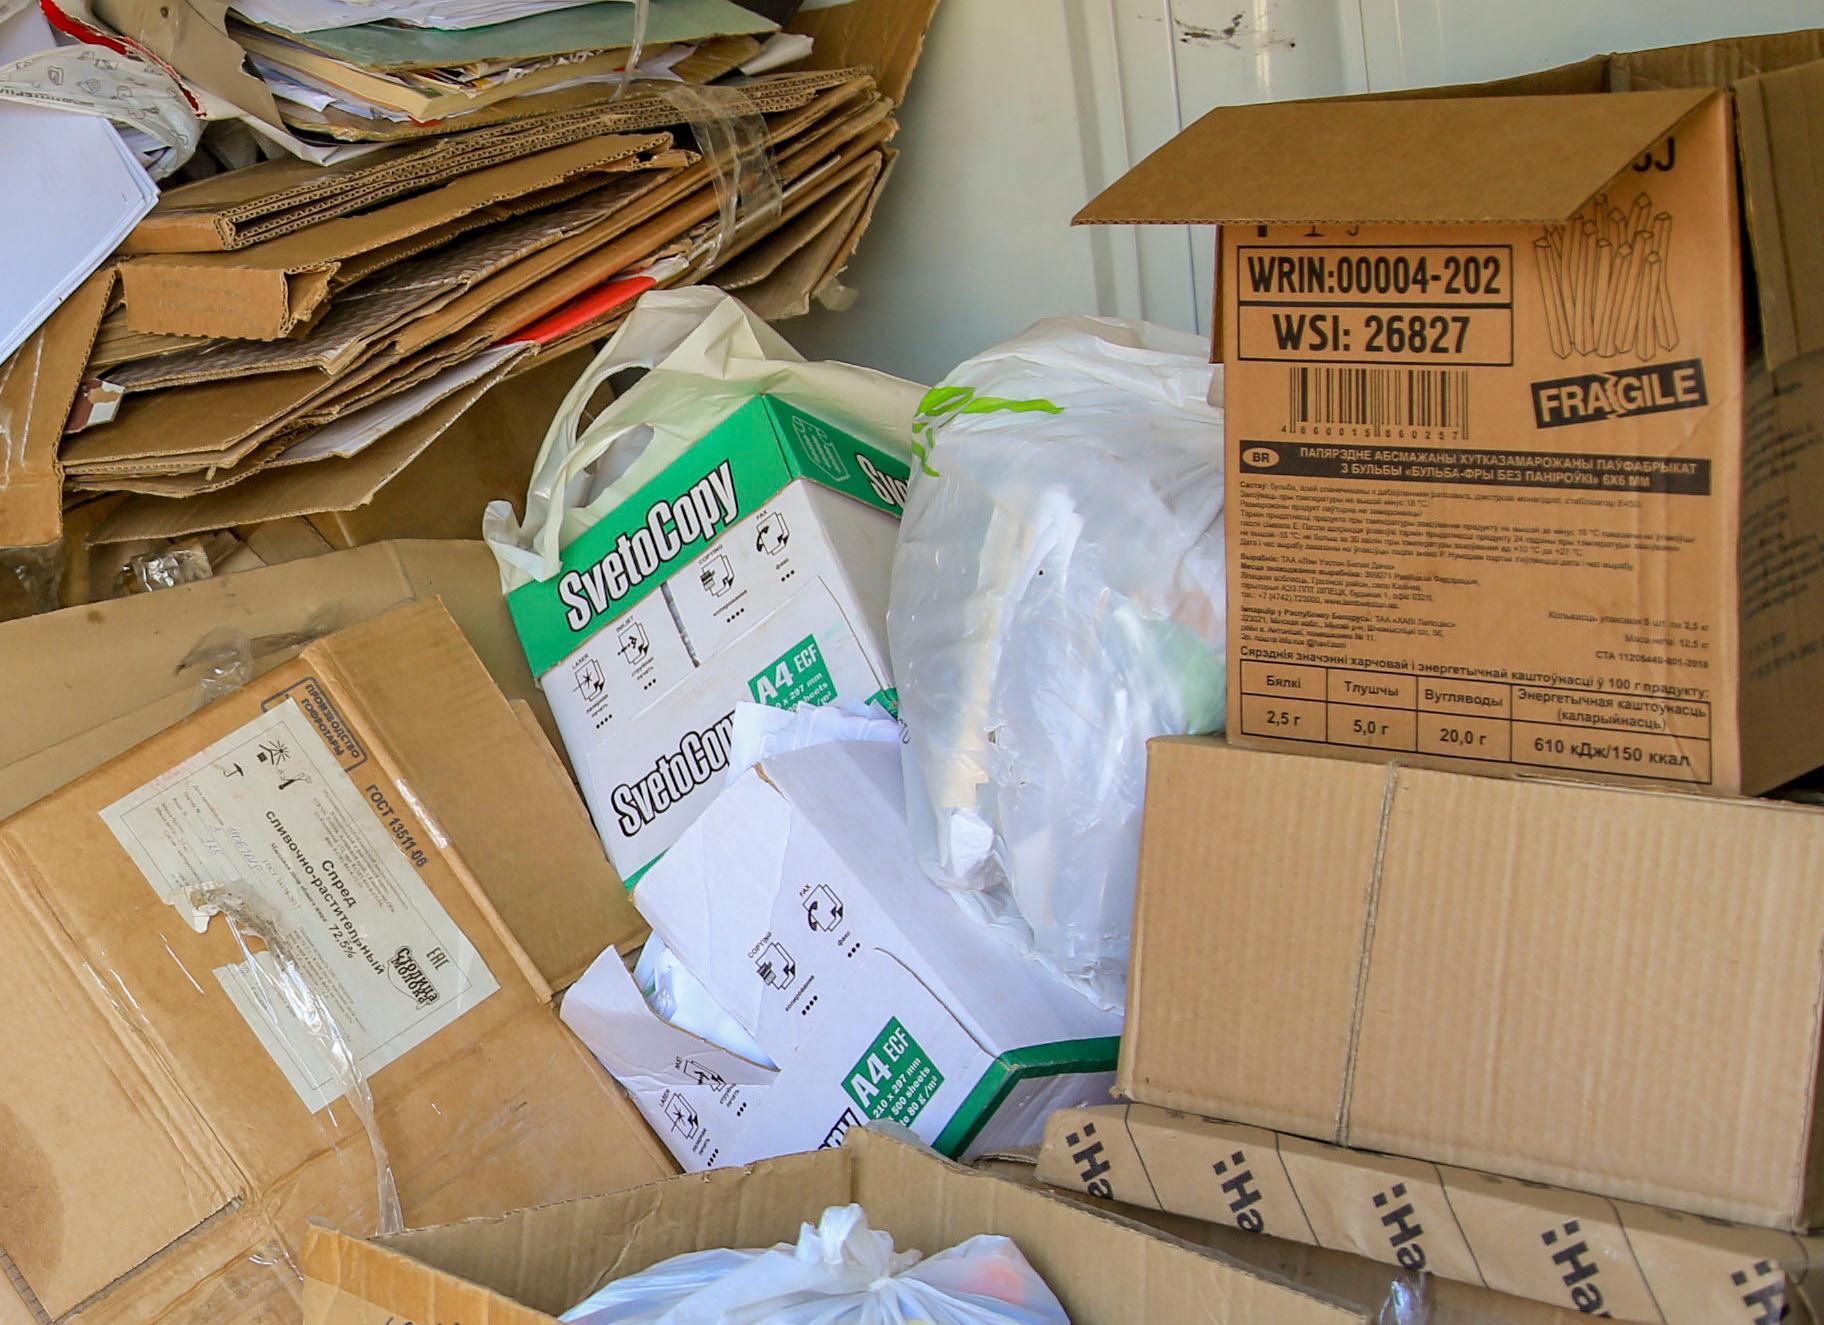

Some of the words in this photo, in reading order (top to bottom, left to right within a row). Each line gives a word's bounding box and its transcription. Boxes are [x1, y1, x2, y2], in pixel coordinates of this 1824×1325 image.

[1248, 256, 1501, 295] WRIN:00004-202
[1273, 314, 1352, 352] WSI:
[1364, 315, 1472, 354] 26827
[1538, 367, 1702, 423] FRAGILE
[1252, 452, 1270, 463] BR
[1351, 463, 1403, 476] БУЛЬБЫ
[1498, 469, 1522, 481] БЕЗ
[1375, 450, 1457, 464] АБСМАЖАНЫ
[1460, 452, 1593, 470] ХУТКАЗАМАРОЖАНЫ
[558, 459, 739, 633] SvetoCopy
[756, 661, 795, 705] A4
[793, 643, 819, 673] ECF
[1240, 646, 1294, 660] Сярэднія
[1295, 651, 1348, 665] значэнні
[1350, 656, 1408, 671] харчовай
[1511, 670, 1594, 688] каштоўнасці
[1609, 678, 1631, 690] 100
[1266, 674, 1302, 689] Бялкі
[788, 683, 805, 700] 297
[803, 682, 829, 704] heets
[1344, 680, 1399, 697] Тлушчы
[1424, 688, 1503, 707] Вугляводы
[1518, 688, 1613, 709] Энергетычная
[1617, 700, 1706, 719] каштоўнасць
[301, 698, 345, 757] ГОФРОТАРЫ
[304, 683, 360, 759] ПРОИЗВОДСТВО
[1266, 711, 1289, 726] 2,5
[1353, 719, 1377, 736] 5,0
[1557, 708, 1667, 731] (каларыйнасць)
[1440, 728, 1474, 745] 20,0
[1534, 737, 1565, 753] 610
[1570, 741, 1643, 762] кДж/150
[1648, 751, 1691, 767] ккал
[610, 708, 736, 838] SvetoCop
[366, 783, 395, 818] ГОСТ
[320, 859, 358, 910] Спред
[799, 883, 813, 898] FAX
[327, 923, 356, 960] 72,5%
[389, 955, 429, 1005] Молока
[395, 945, 441, 1003] Столица
[850, 1052, 892, 1108] A4
[882, 1026, 911, 1062] ECF
[871, 1099, 888, 1118] 210
[904, 1056, 922, 1074] mm
[892, 1098, 908, 1116] 500
[907, 1101, 921, 1117] 80
